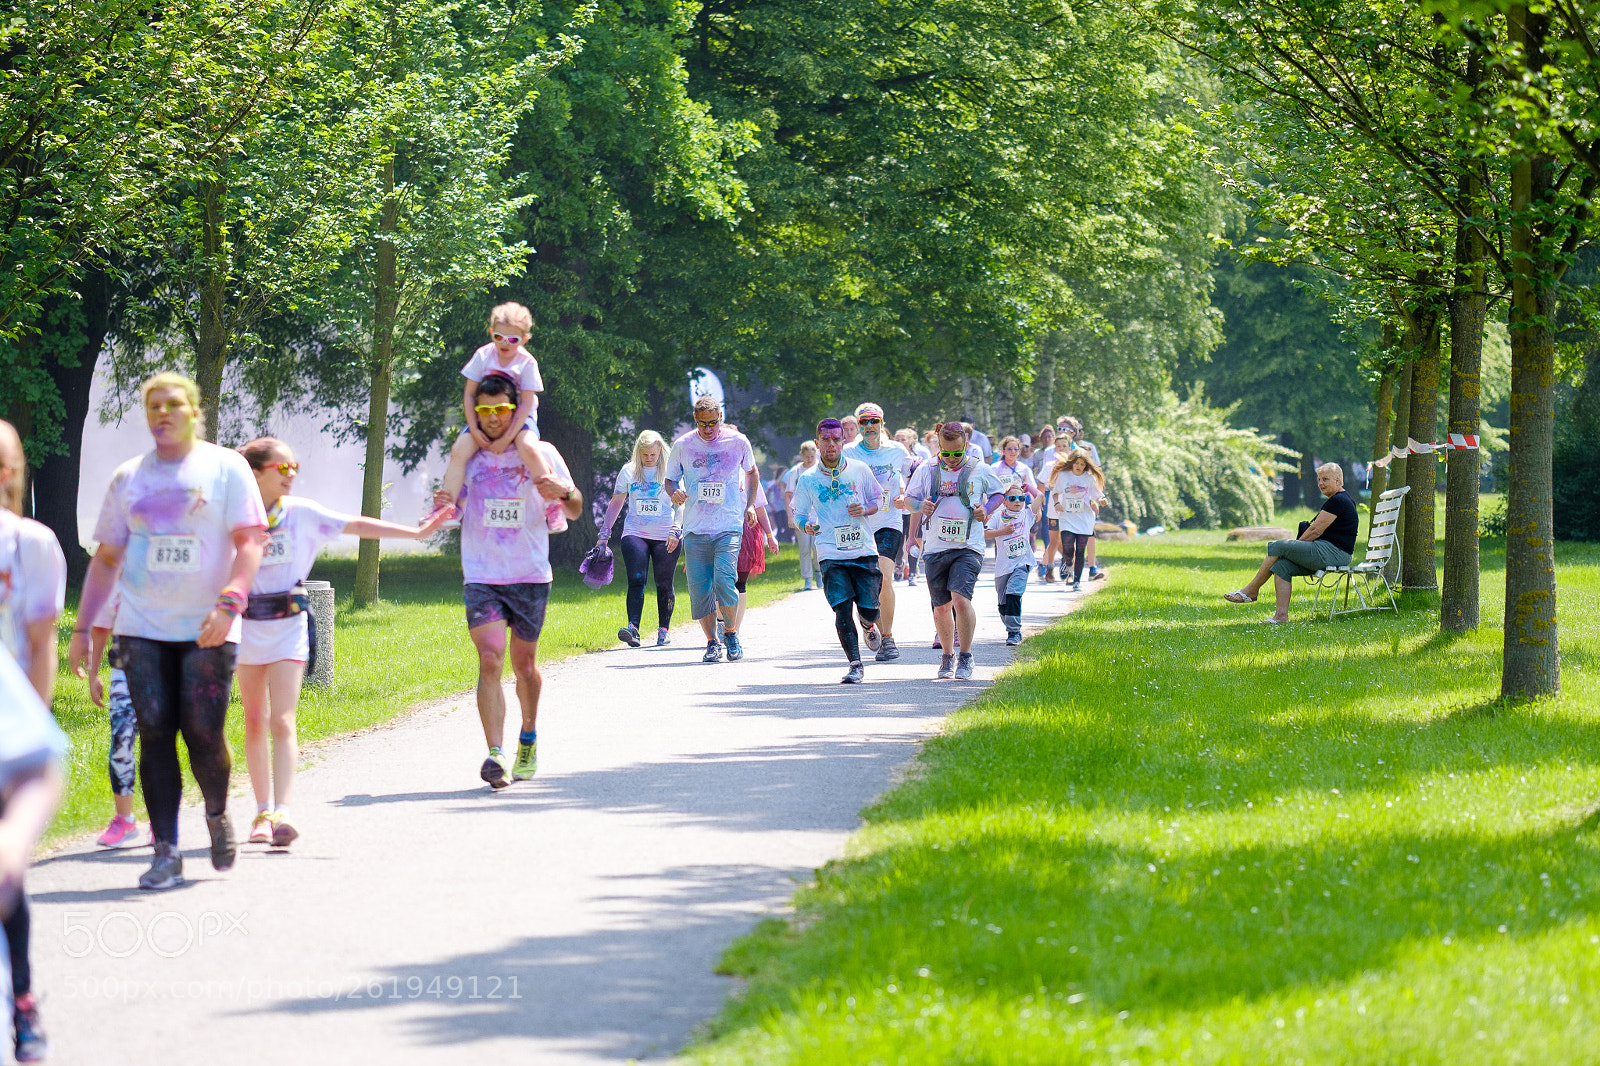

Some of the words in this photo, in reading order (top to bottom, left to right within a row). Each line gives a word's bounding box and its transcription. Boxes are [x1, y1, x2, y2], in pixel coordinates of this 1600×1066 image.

[702, 488, 721, 497] 5173
[641, 504, 658, 512] 7836
[490, 509, 518, 521] 8434
[941, 525, 960, 535] 8481
[840, 531, 861, 543] 8482
[157, 548, 190, 563] 8736
